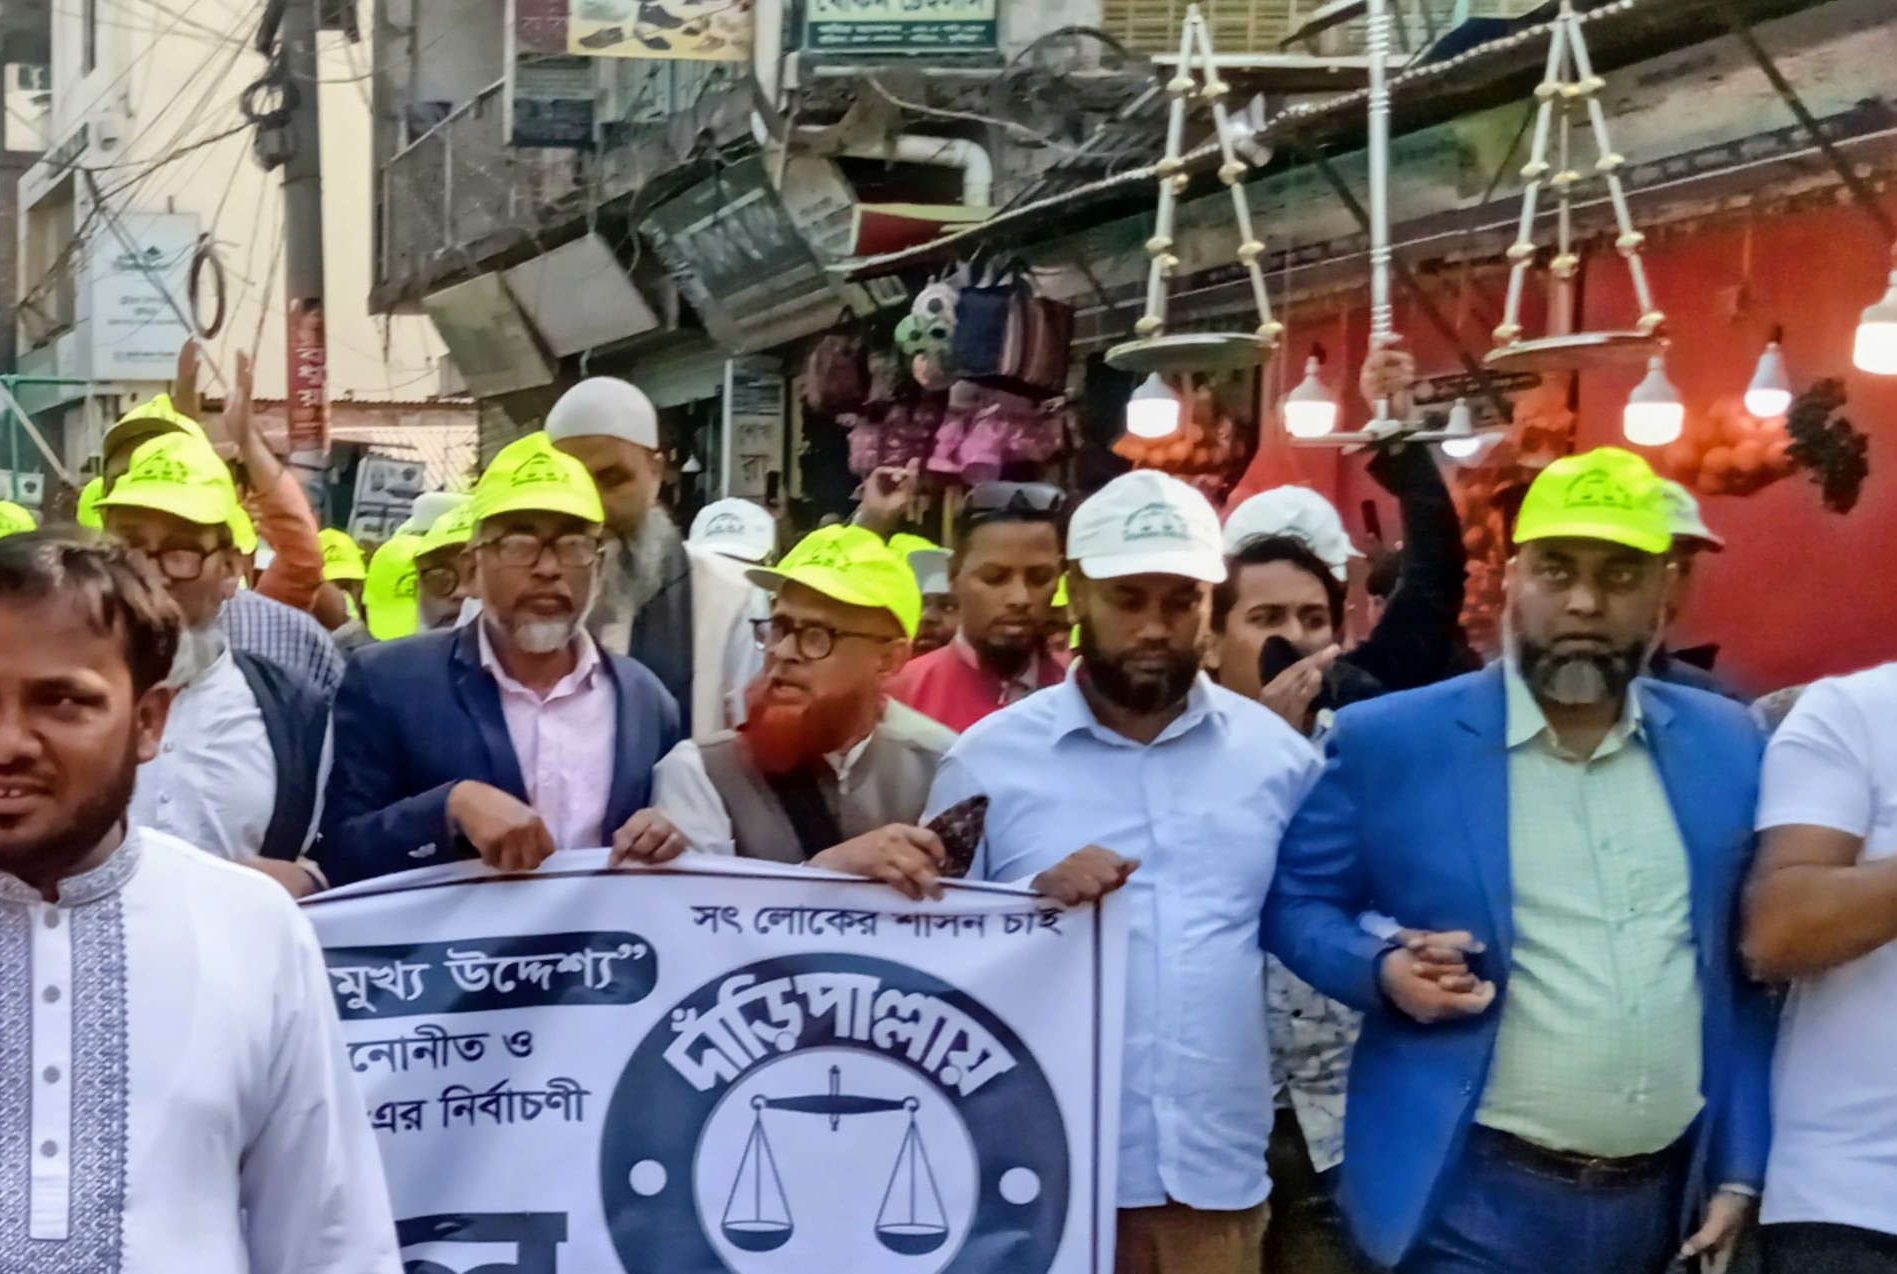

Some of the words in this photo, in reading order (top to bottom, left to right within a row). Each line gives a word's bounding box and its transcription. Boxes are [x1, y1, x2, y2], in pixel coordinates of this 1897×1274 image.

[690, 905, 743, 934] সৎ
[754, 904, 881, 937] লোকের
[999, 907, 1065, 936] চাই
[327, 960, 432, 1013] মুখ্য
[346, 1023, 491, 1073] নোনীত
[502, 1031, 534, 1058] ও
